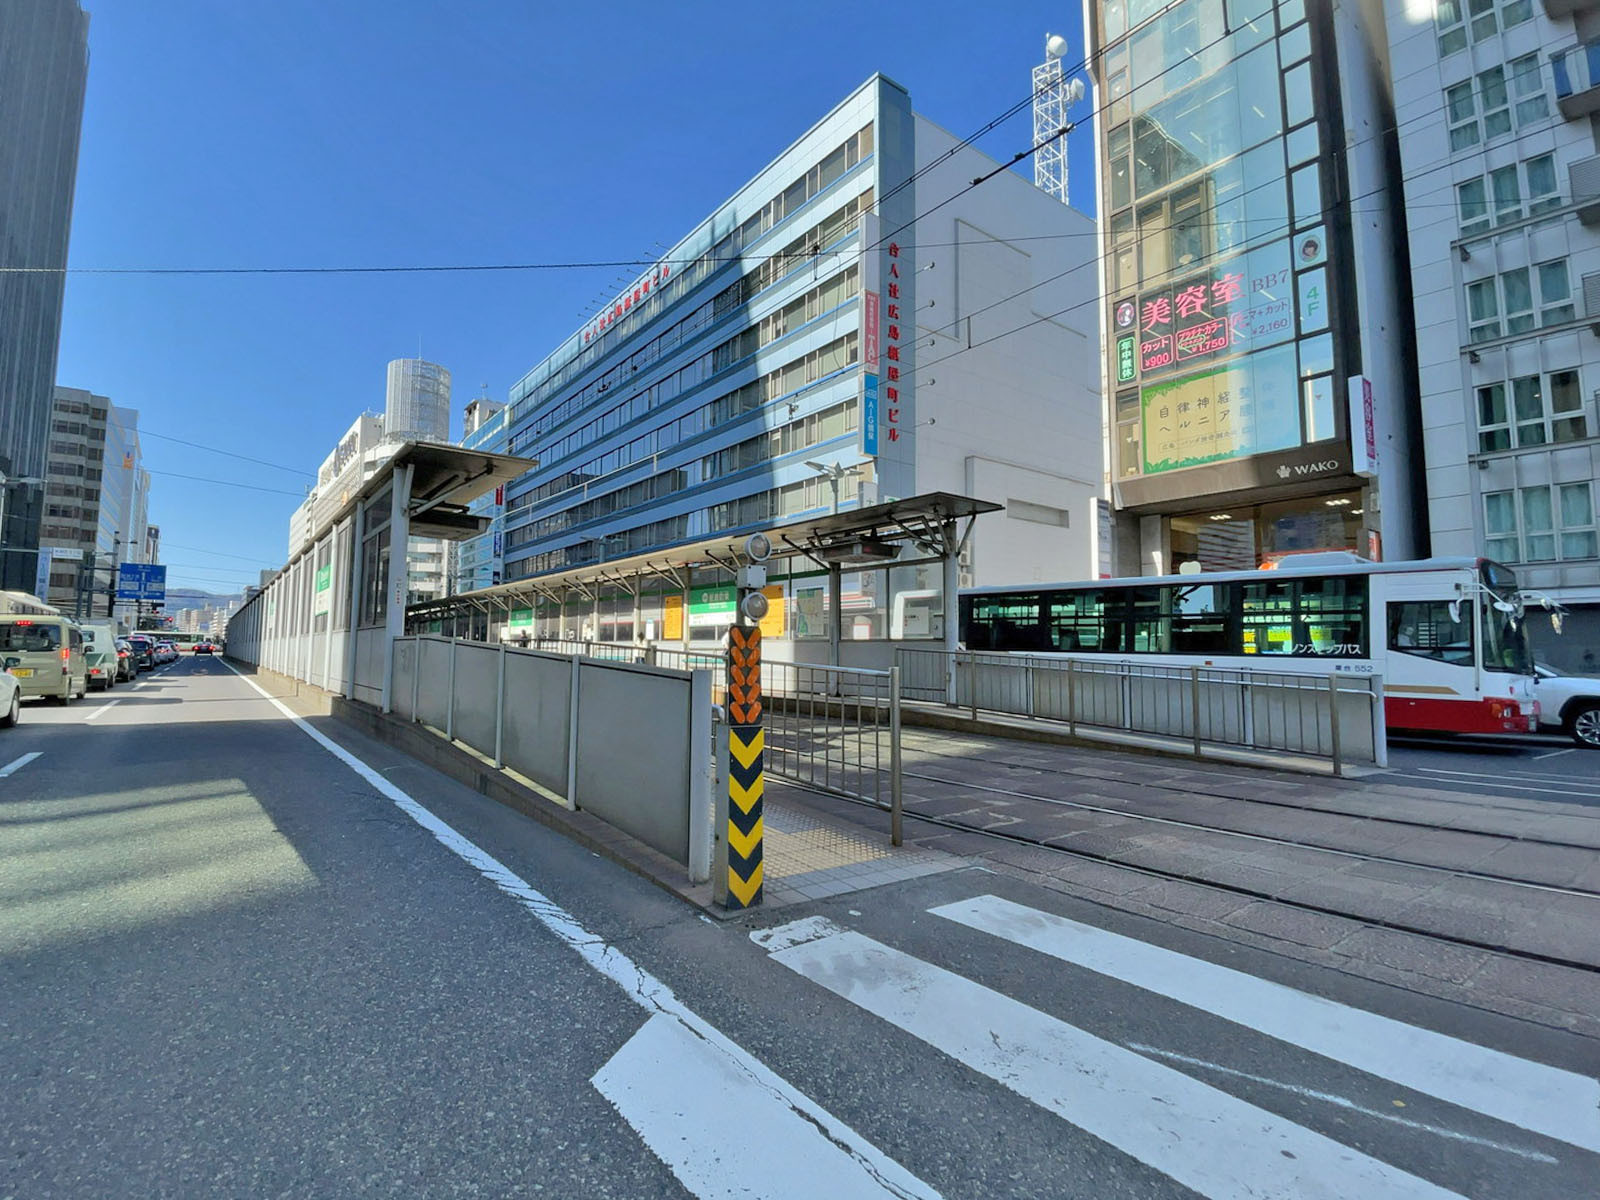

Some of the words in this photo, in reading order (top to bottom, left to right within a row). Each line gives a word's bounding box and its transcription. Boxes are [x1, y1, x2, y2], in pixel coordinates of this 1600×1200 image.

[1252, 268, 1289, 293] BB7
[1141, 271, 1247, 332] 美容室
[887, 242, 900, 442] 合人社広島紙屋町ビル
[1142, 337, 1169, 354] カット
[1145, 352, 1169, 367] ¥900
[1294, 459, 1339, 475] WAKO
[1354, 664, 1374, 673] 552
